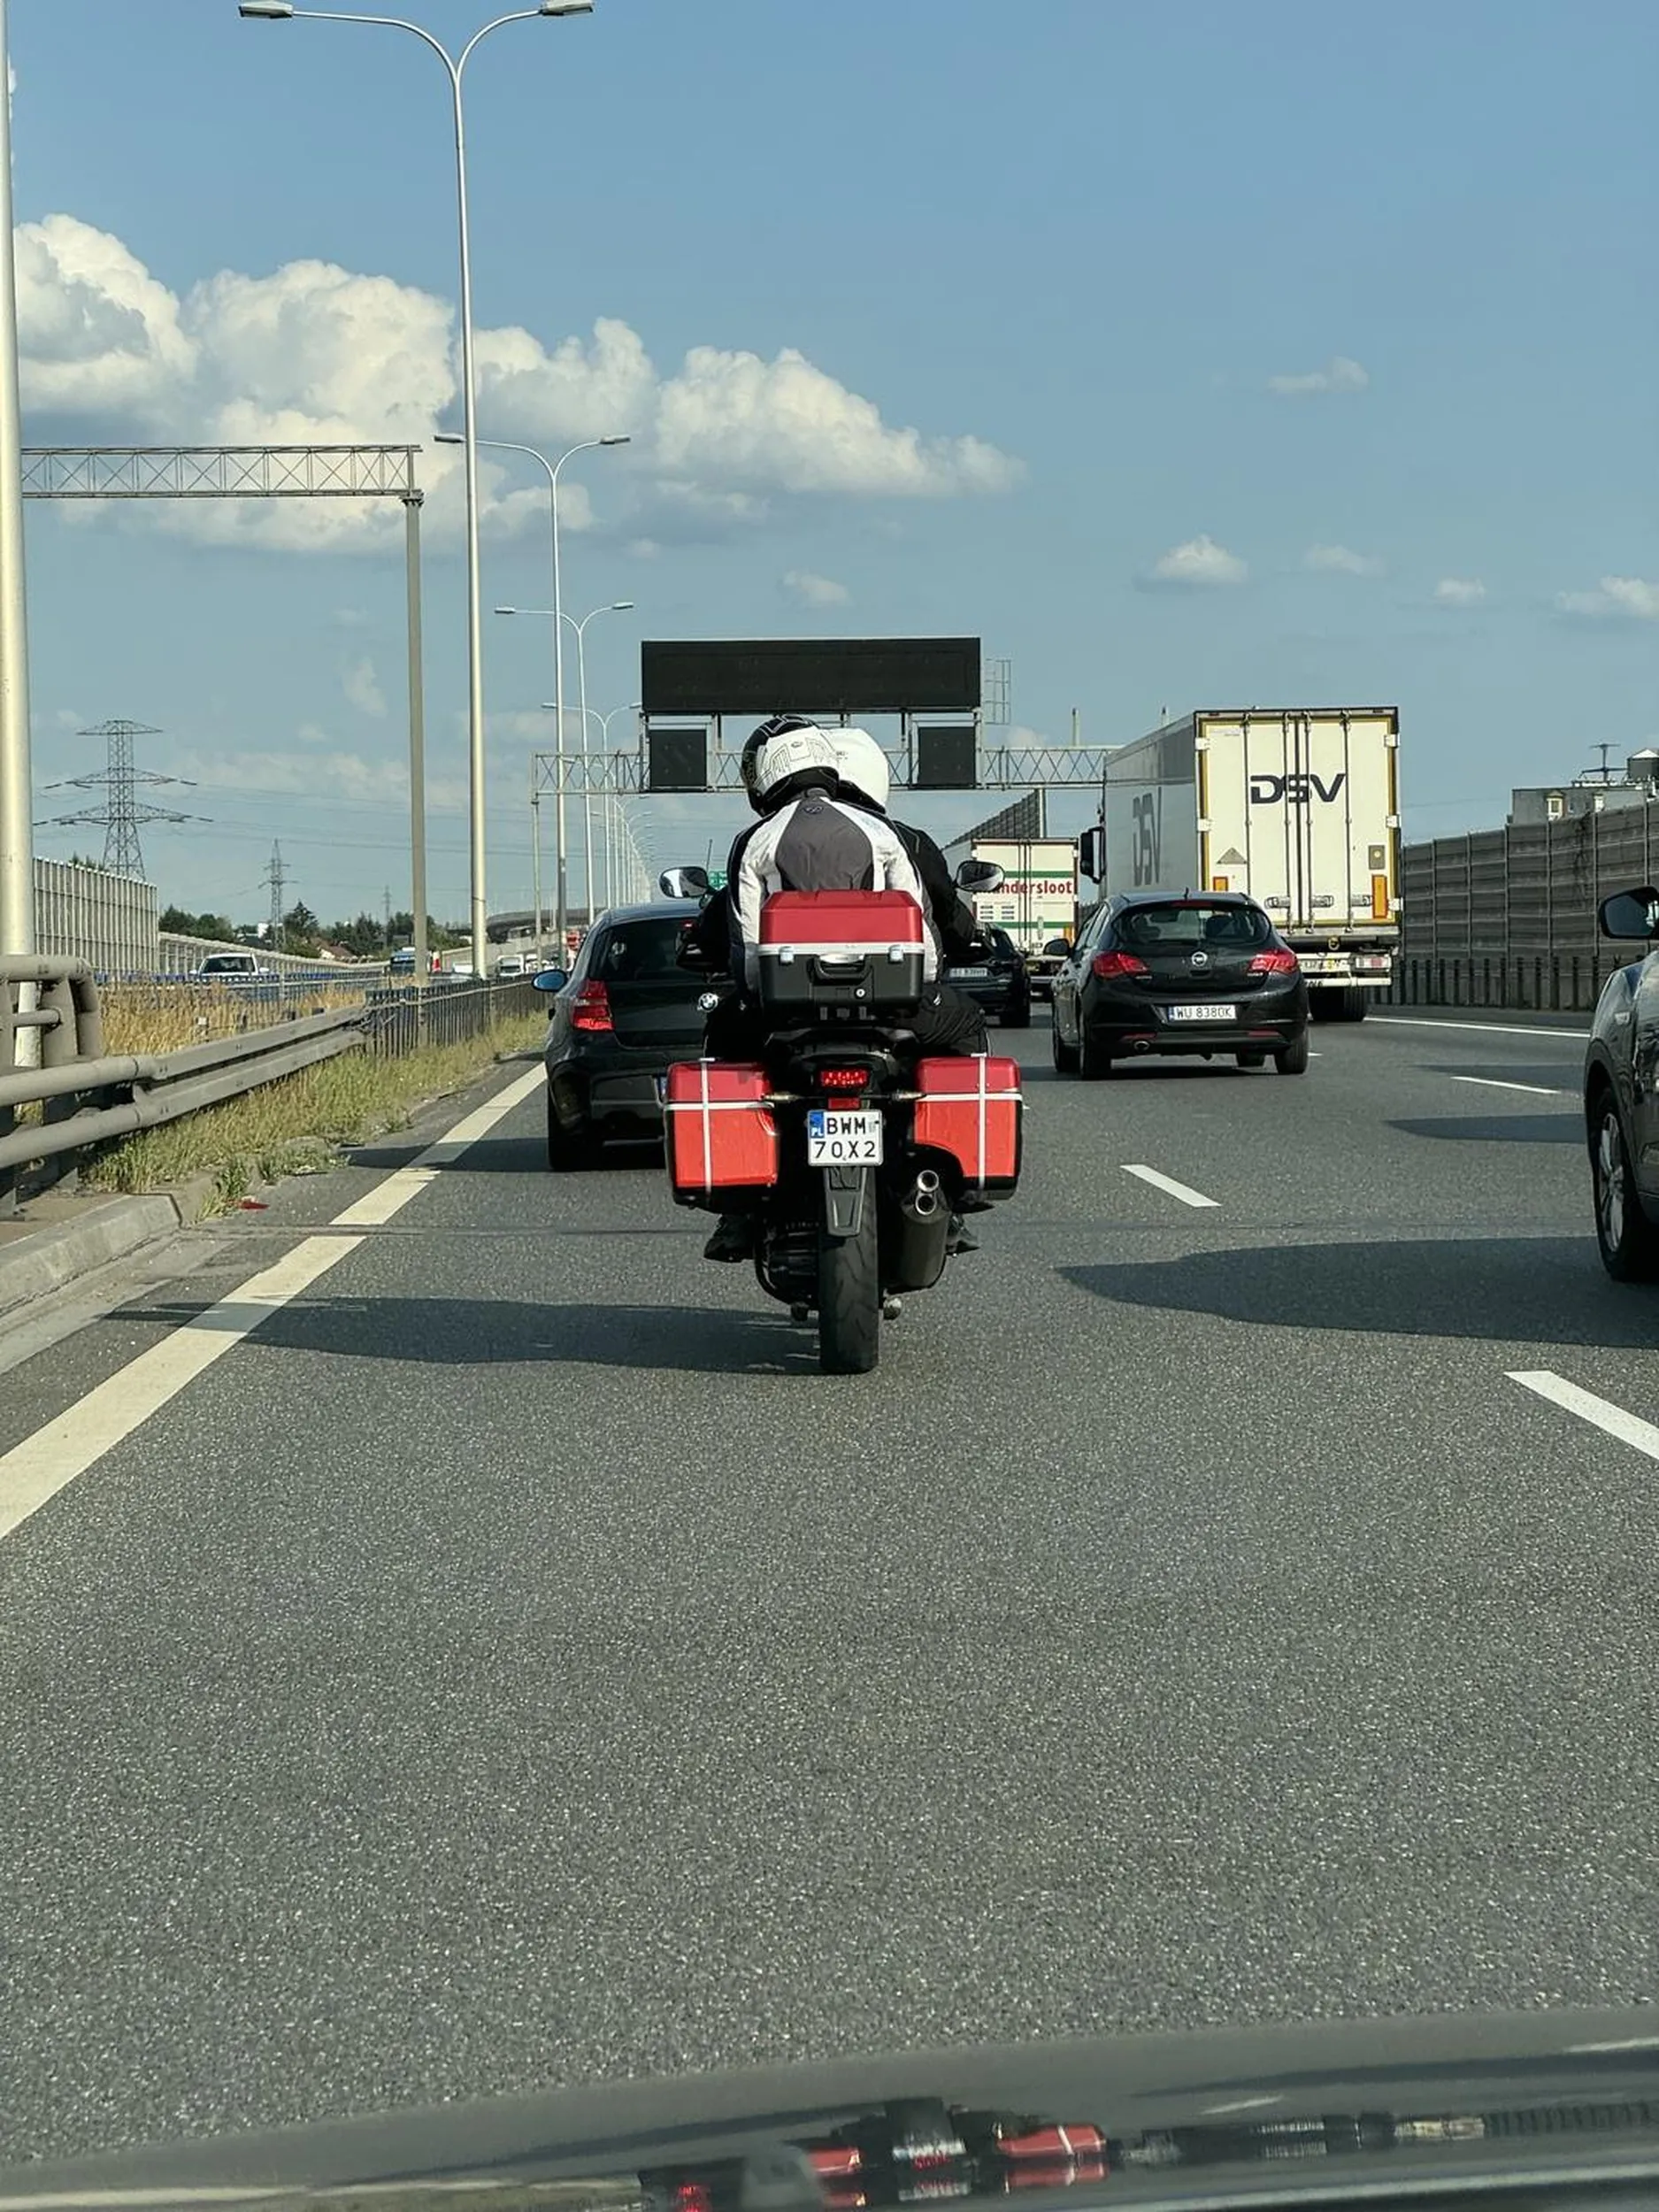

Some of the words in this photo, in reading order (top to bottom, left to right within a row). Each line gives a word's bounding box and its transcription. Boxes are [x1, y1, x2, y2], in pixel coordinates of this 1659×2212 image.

[1249, 773, 1346, 804] DSV
[995, 879, 1072, 895] ndersloot
[1196, 1007, 1233, 1018] 8380K
[810, 1126, 824, 1137] PL
[826, 1117, 866, 1135] BWM
[814, 1141, 876, 1159] 70X2
